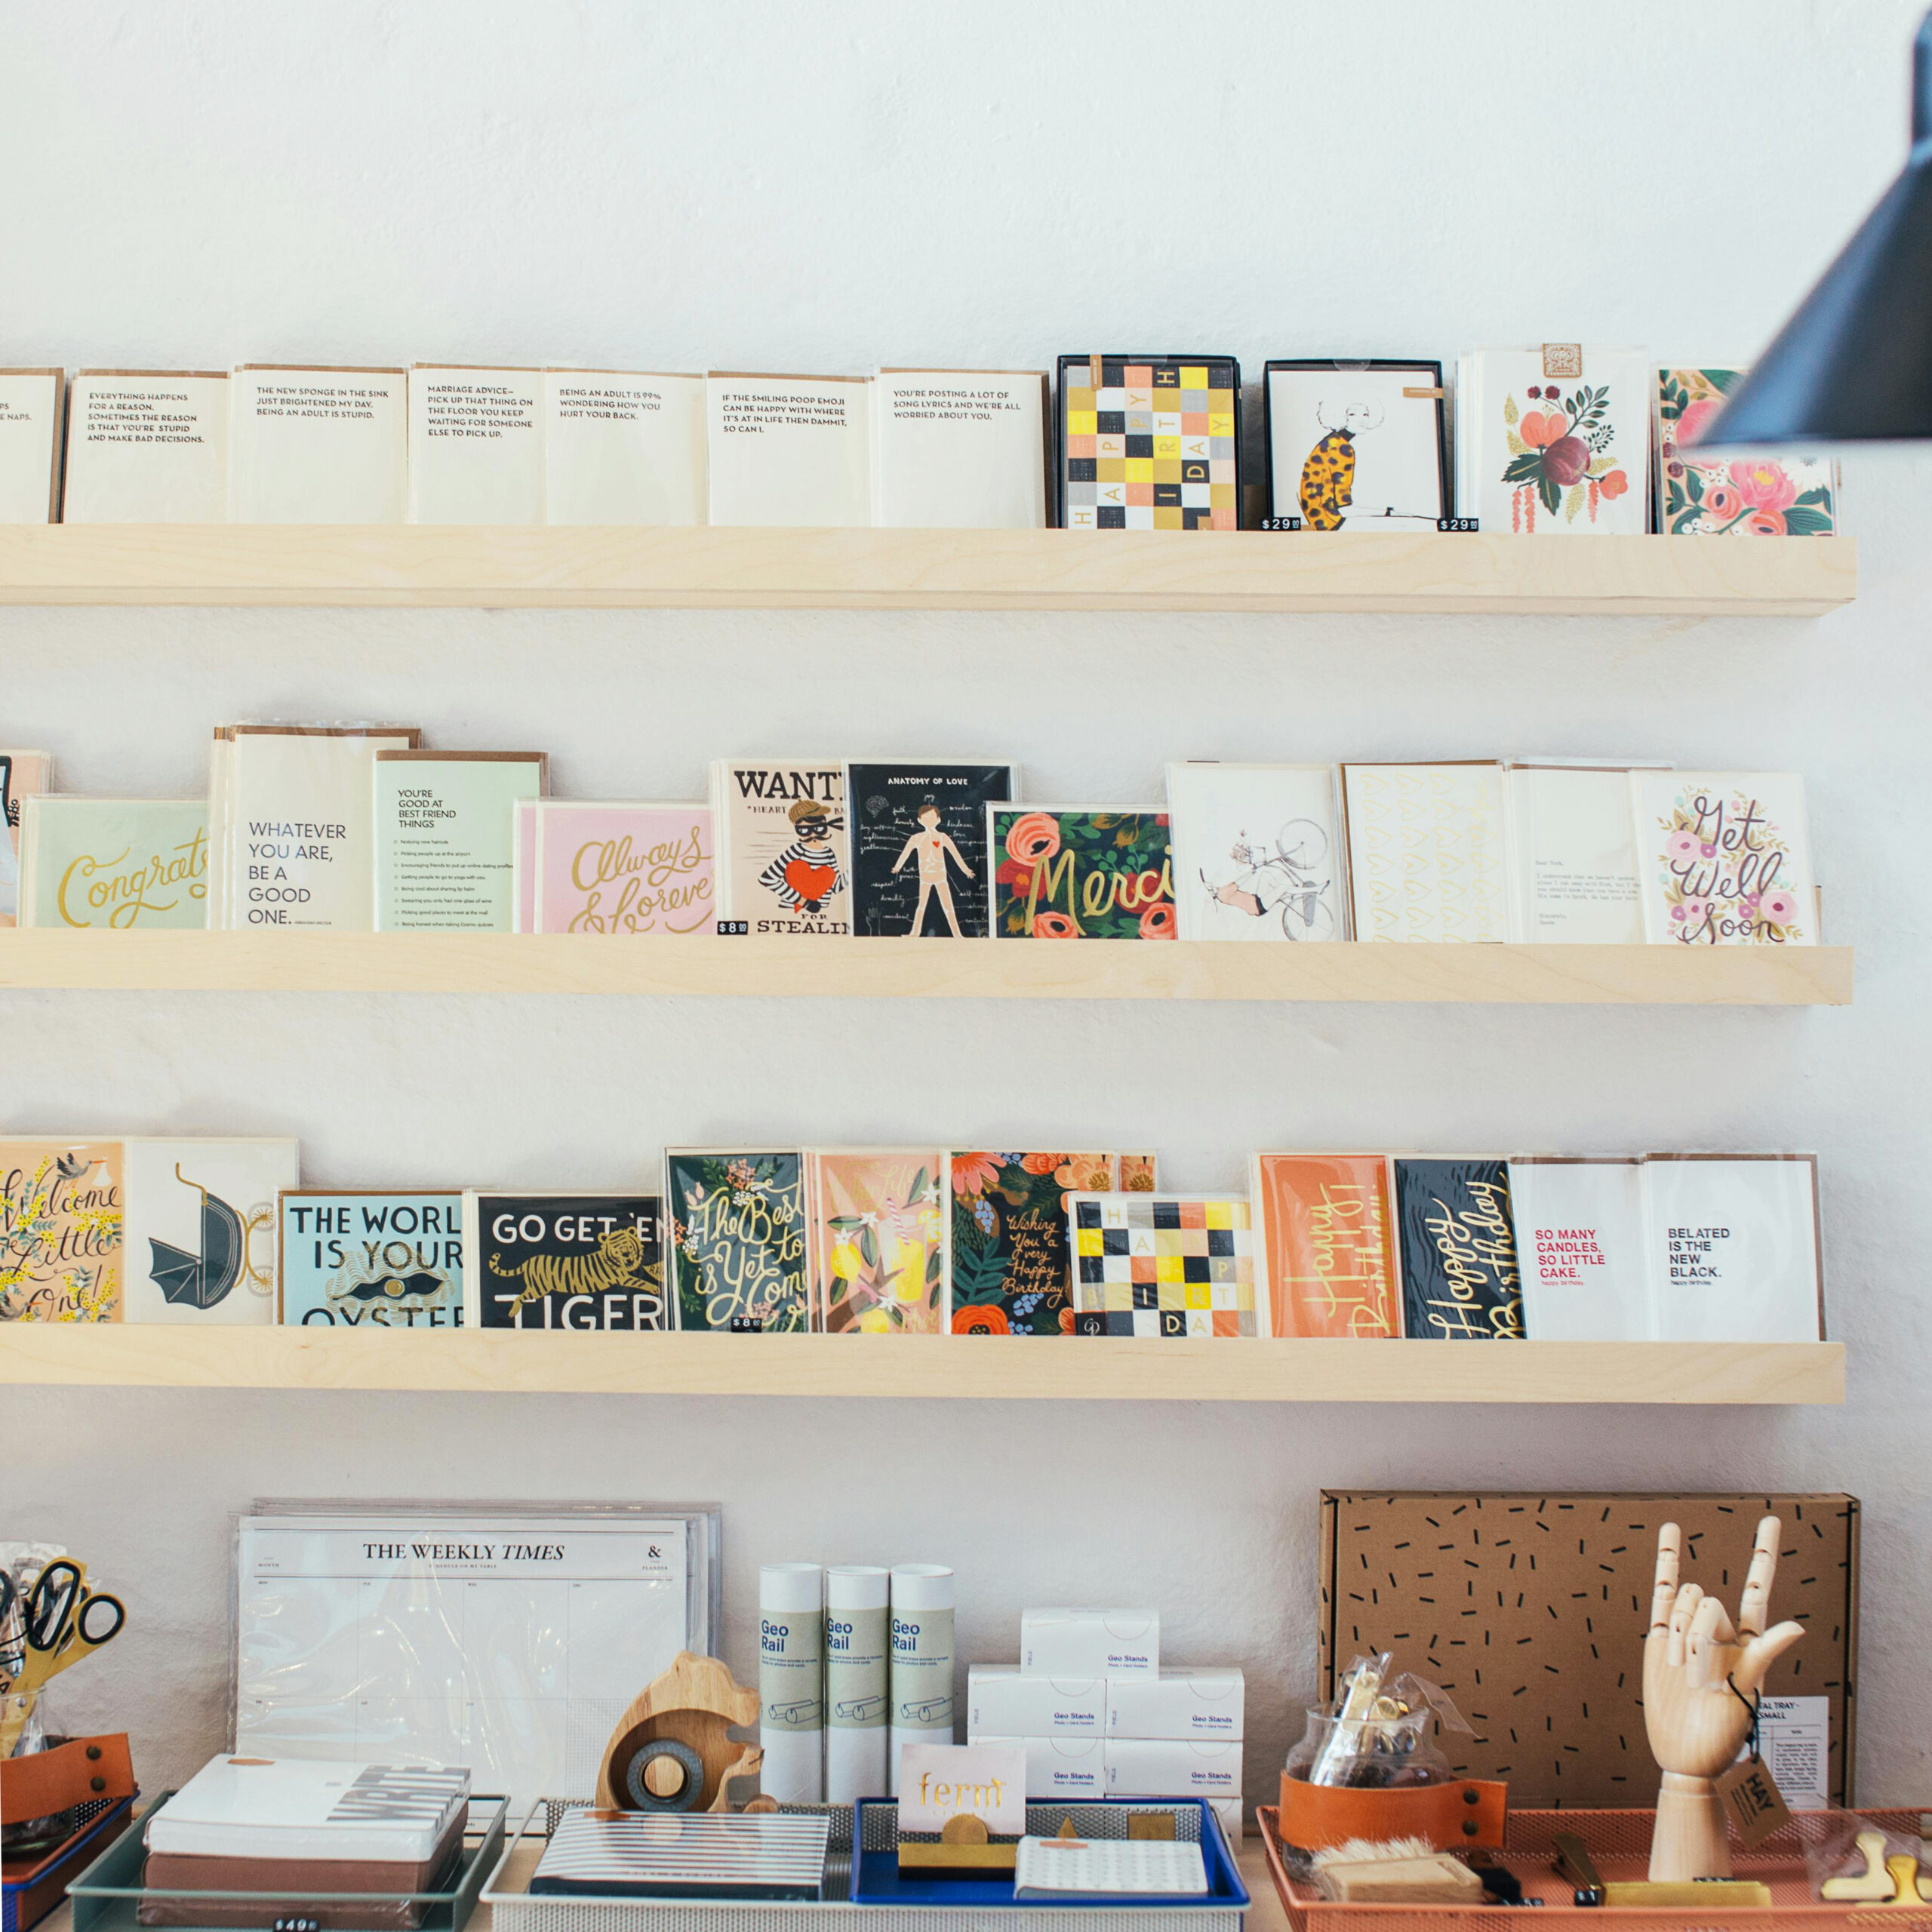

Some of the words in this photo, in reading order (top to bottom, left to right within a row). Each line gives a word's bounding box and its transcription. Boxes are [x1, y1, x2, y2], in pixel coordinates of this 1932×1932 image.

[89, 392, 146, 401] EVERYTHING
[147, 393, 189, 401] HAPPENS
[299, 387, 336, 396] SPONGE
[349, 389, 367, 398] THE
[368, 390, 389, 398] SINK
[893, 389, 926, 398] YOU'RE
[928, 390, 968, 398] POSTING
[977, 391, 995, 399] LOT
[116, 403, 155, 411] REASON.
[279, 398, 337, 408] BRIGHTENED
[354, 400, 374, 408] DAY.
[894, 400, 919, 408] SONG
[921, 400, 952, 408] LYRICS
[974, 401, 1002, 410] WE'RE
[88, 413, 140, 421] SOMETIMES
[141, 414, 159, 422] THE
[256, 408, 284, 416] BEING
[300, 409, 330, 417] ADULT
[341, 411, 374, 419] STUPID.
[937, 411, 968, 420] ABOUT
[971, 412, 992, 420] YOU.
[155, 435, 205, 443] DECISIONS.
[734, 771, 842, 800] WANT
[888, 777, 931, 786] ANATOMY
[946, 777, 968, 786] LOVE
[398, 789, 433, 798] YOU'RE
[398, 799, 430, 808] GOOD
[431, 799, 444, 808] AT
[398, 810, 421, 818] BEST
[423, 810, 457, 819] FRIEND
[248, 822, 346, 839] WHATEVER
[398, 820, 435, 829] THINGS
[1681, 796, 1765, 851] Get
[248, 843, 290, 859] YOU
[294, 844, 333, 863] ARE,
[248, 865, 269, 881] BE
[274, 866, 288, 881] A
[1670, 852, 1783, 898] Well
[248, 887, 311, 903] GOOD
[1026, 844, 1176, 935] Merci
[248, 909, 292, 924] ONE.
[1677, 903, 1785, 944] Soon
[688, 1187, 739, 1244] The
[740, 1179, 804, 1244] Best
[290, 1208, 350, 1233] THE
[1007, 1208, 1059, 1241] Wishing
[493, 1214, 546, 1244] GO
[555, 1217, 617, 1241] GET
[1534, 1229, 1554, 1241] SO
[1557, 1229, 1596, 1240] MANY
[1668, 1228, 1730, 1238] BELATED
[315, 1241, 343, 1269] IS
[363, 1240, 463, 1269] YOUR
[1010, 1234, 1038, 1259] You
[1048, 1238, 1058, 1247] a
[1283, 1183, 1367, 1317] Happy
[1537, 1241, 1601, 1253] CANDLES,
[1669, 1241, 1682, 1252] IS
[1684, 1241, 1712, 1252] THE
[694, 1264, 718, 1295] is
[773, 1229, 805, 1264] to
[1024, 1251, 1051, 1268] very
[1537, 1254, 1557, 1266] SO
[1560, 1254, 1606, 1266] LITTLE
[1669, 1254, 1701, 1265] NEW
[1008, 1259, 1060, 1282] Happy
[1425, 1198, 1490, 1338] Happy
[1540, 1267, 1581, 1278] CAKE.
[1670, 1266, 1721, 1278] BLACK.
[362, 1543, 407, 1559] THE
[411, 1544, 496, 1560] WEEKLY
[503, 1545, 565, 1560] TIMES
[648, 1545, 661, 1558] &
[761, 1620, 789, 1636] Geo
[828, 1618, 852, 1634] Geo
[893, 1619, 919, 1635] Geo
[761, 1635, 785, 1652] Rail
[827, 1634, 849, 1650] Rail
[893, 1635, 915, 1651] Rail
[1054, 1771, 1069, 1780] Geo
[1070, 1772, 1094, 1780] Stands
[1208, 1771, 1232, 1780] Stands
[1746, 1772, 1774, 1811] HAY
